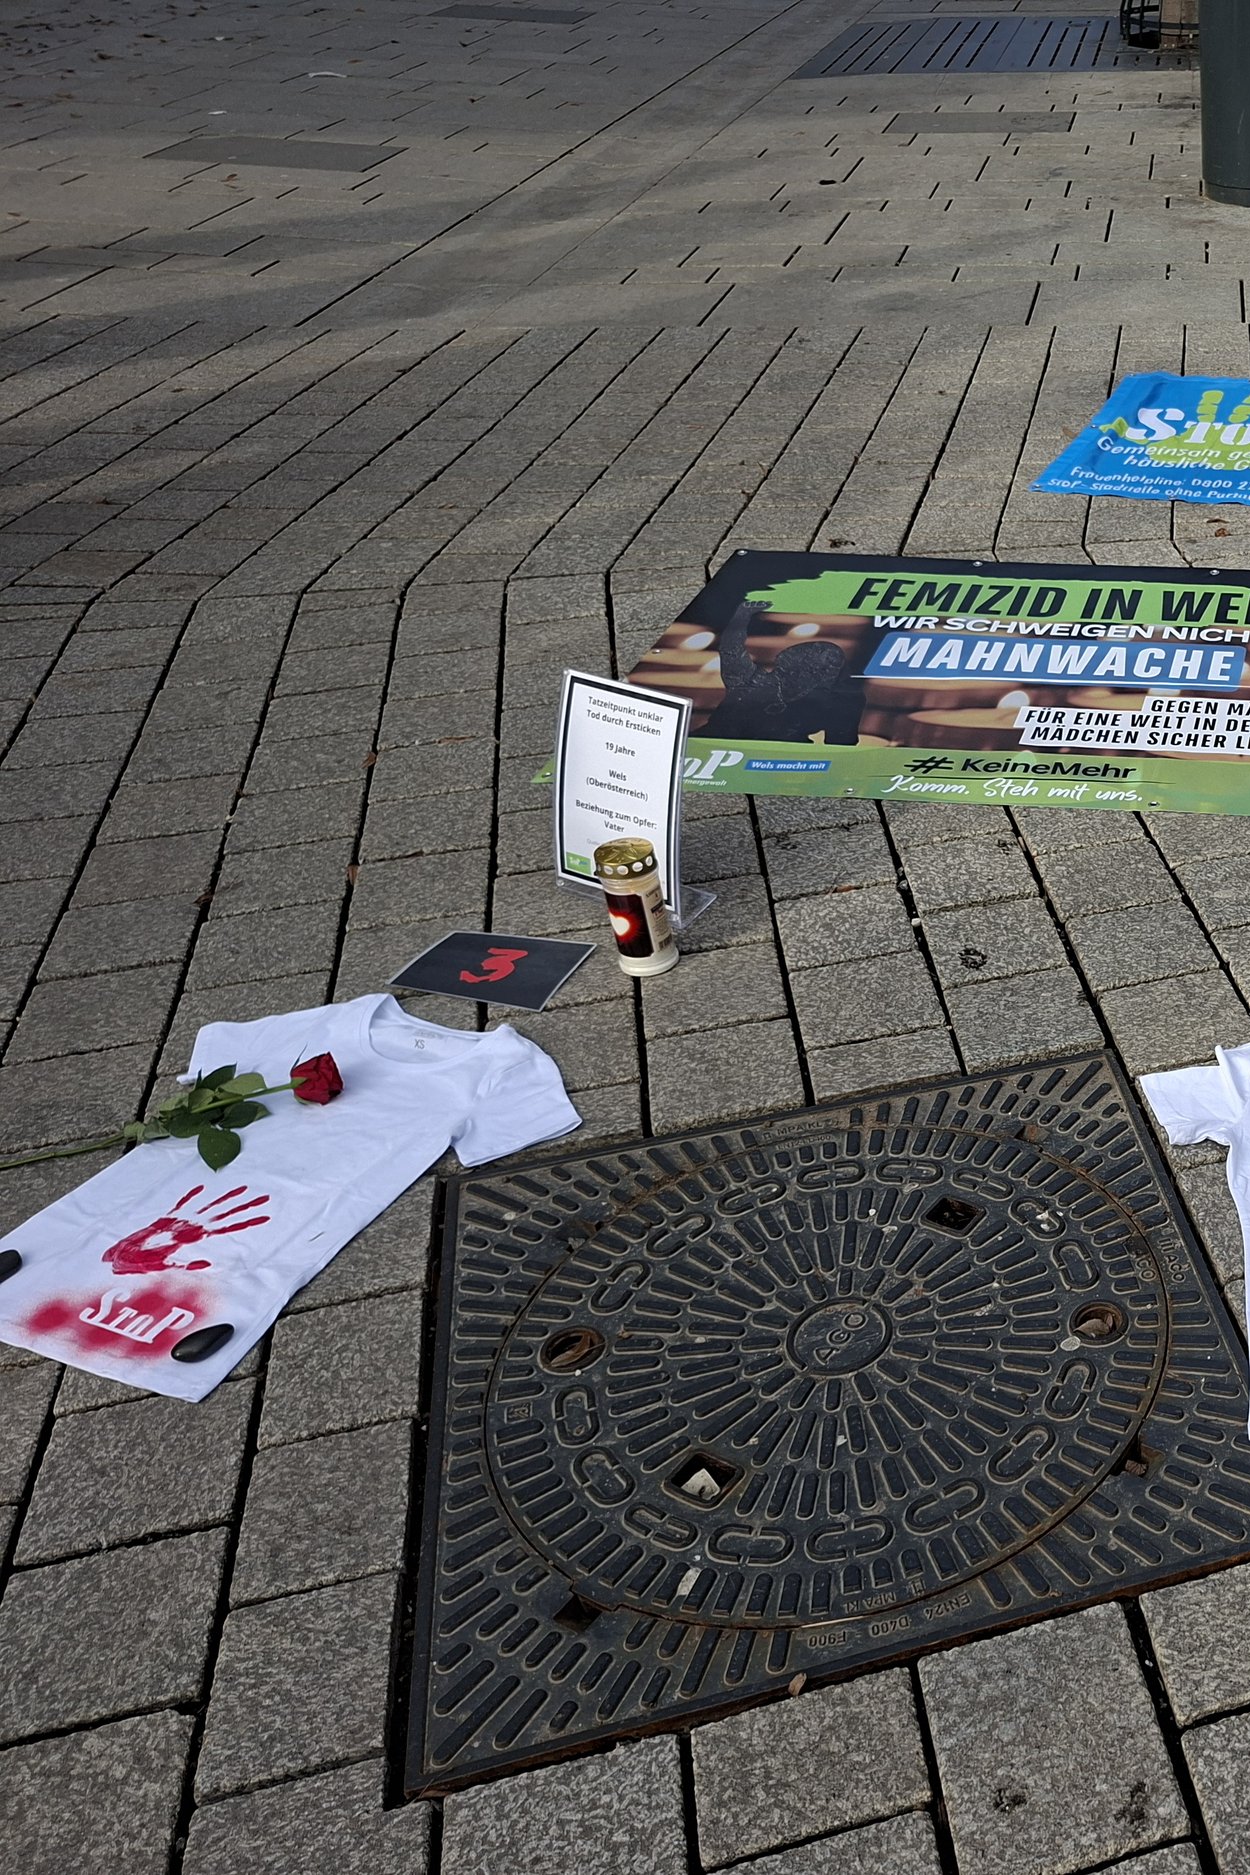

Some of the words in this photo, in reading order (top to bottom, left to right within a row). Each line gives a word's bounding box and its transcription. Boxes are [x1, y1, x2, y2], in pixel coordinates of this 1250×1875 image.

[1097, 436, 1224, 458] Gemeinsam
[1124, 455, 1225, 471] häusliche
[1165, 487, 1202, 497] ohne
[1191, 479, 1232, 489] 0800
[847, 577, 1068, 618] FEMIZID
[1080, 588, 1144, 621] IN
[873, 615, 940, 630] WIR
[942, 617, 1156, 639] SCHWEIGEN
[879, 637, 1235, 682] MAHNWACHE
[588, 695, 636, 717] Tatzeitpunkt
[637, 710, 664, 723] unklar
[1024, 707, 1066, 724] FÜR
[1074, 712, 1122, 727] EINE
[1130, 714, 1187, 730] WELT
[1193, 717, 1217, 731] IN
[1150, 699, 1219, 715] GEGEN
[586, 709, 600, 721] Tod
[601, 713, 624, 727] durch
[625, 719, 661, 737] Ersticken
[1030, 724, 1139, 744] MÄDCHEN
[1146, 732, 1227, 748] SICHER
[605, 741, 614, 751] 19
[614, 743, 636, 757] Jahre
[608, 769, 627, 782] Wels
[751, 761, 775, 769] Wels
[777, 762, 806, 770] macht
[808, 762, 826, 770] mit
[585, 777, 649, 802] (Oberösterreich)
[880, 774, 970, 795] Komm.
[982, 777, 1039, 798] Steh
[1047, 783, 1090, 801] mit
[1095, 788, 1143, 802] uns.
[575, 799, 614, 819] Beziehung
[615, 811, 632, 823] zum
[632, 815, 658, 830] Opfer:
[604, 820, 625, 834] Vater
[459, 946, 529, 984] 3
[414, 1038, 425, 1050] XS
[813, 1311, 869, 1365] ACO
[923, 1592, 972, 1620] EN124
[870, 1615, 911, 1637] D400
[808, 1630, 848, 1648] F900
